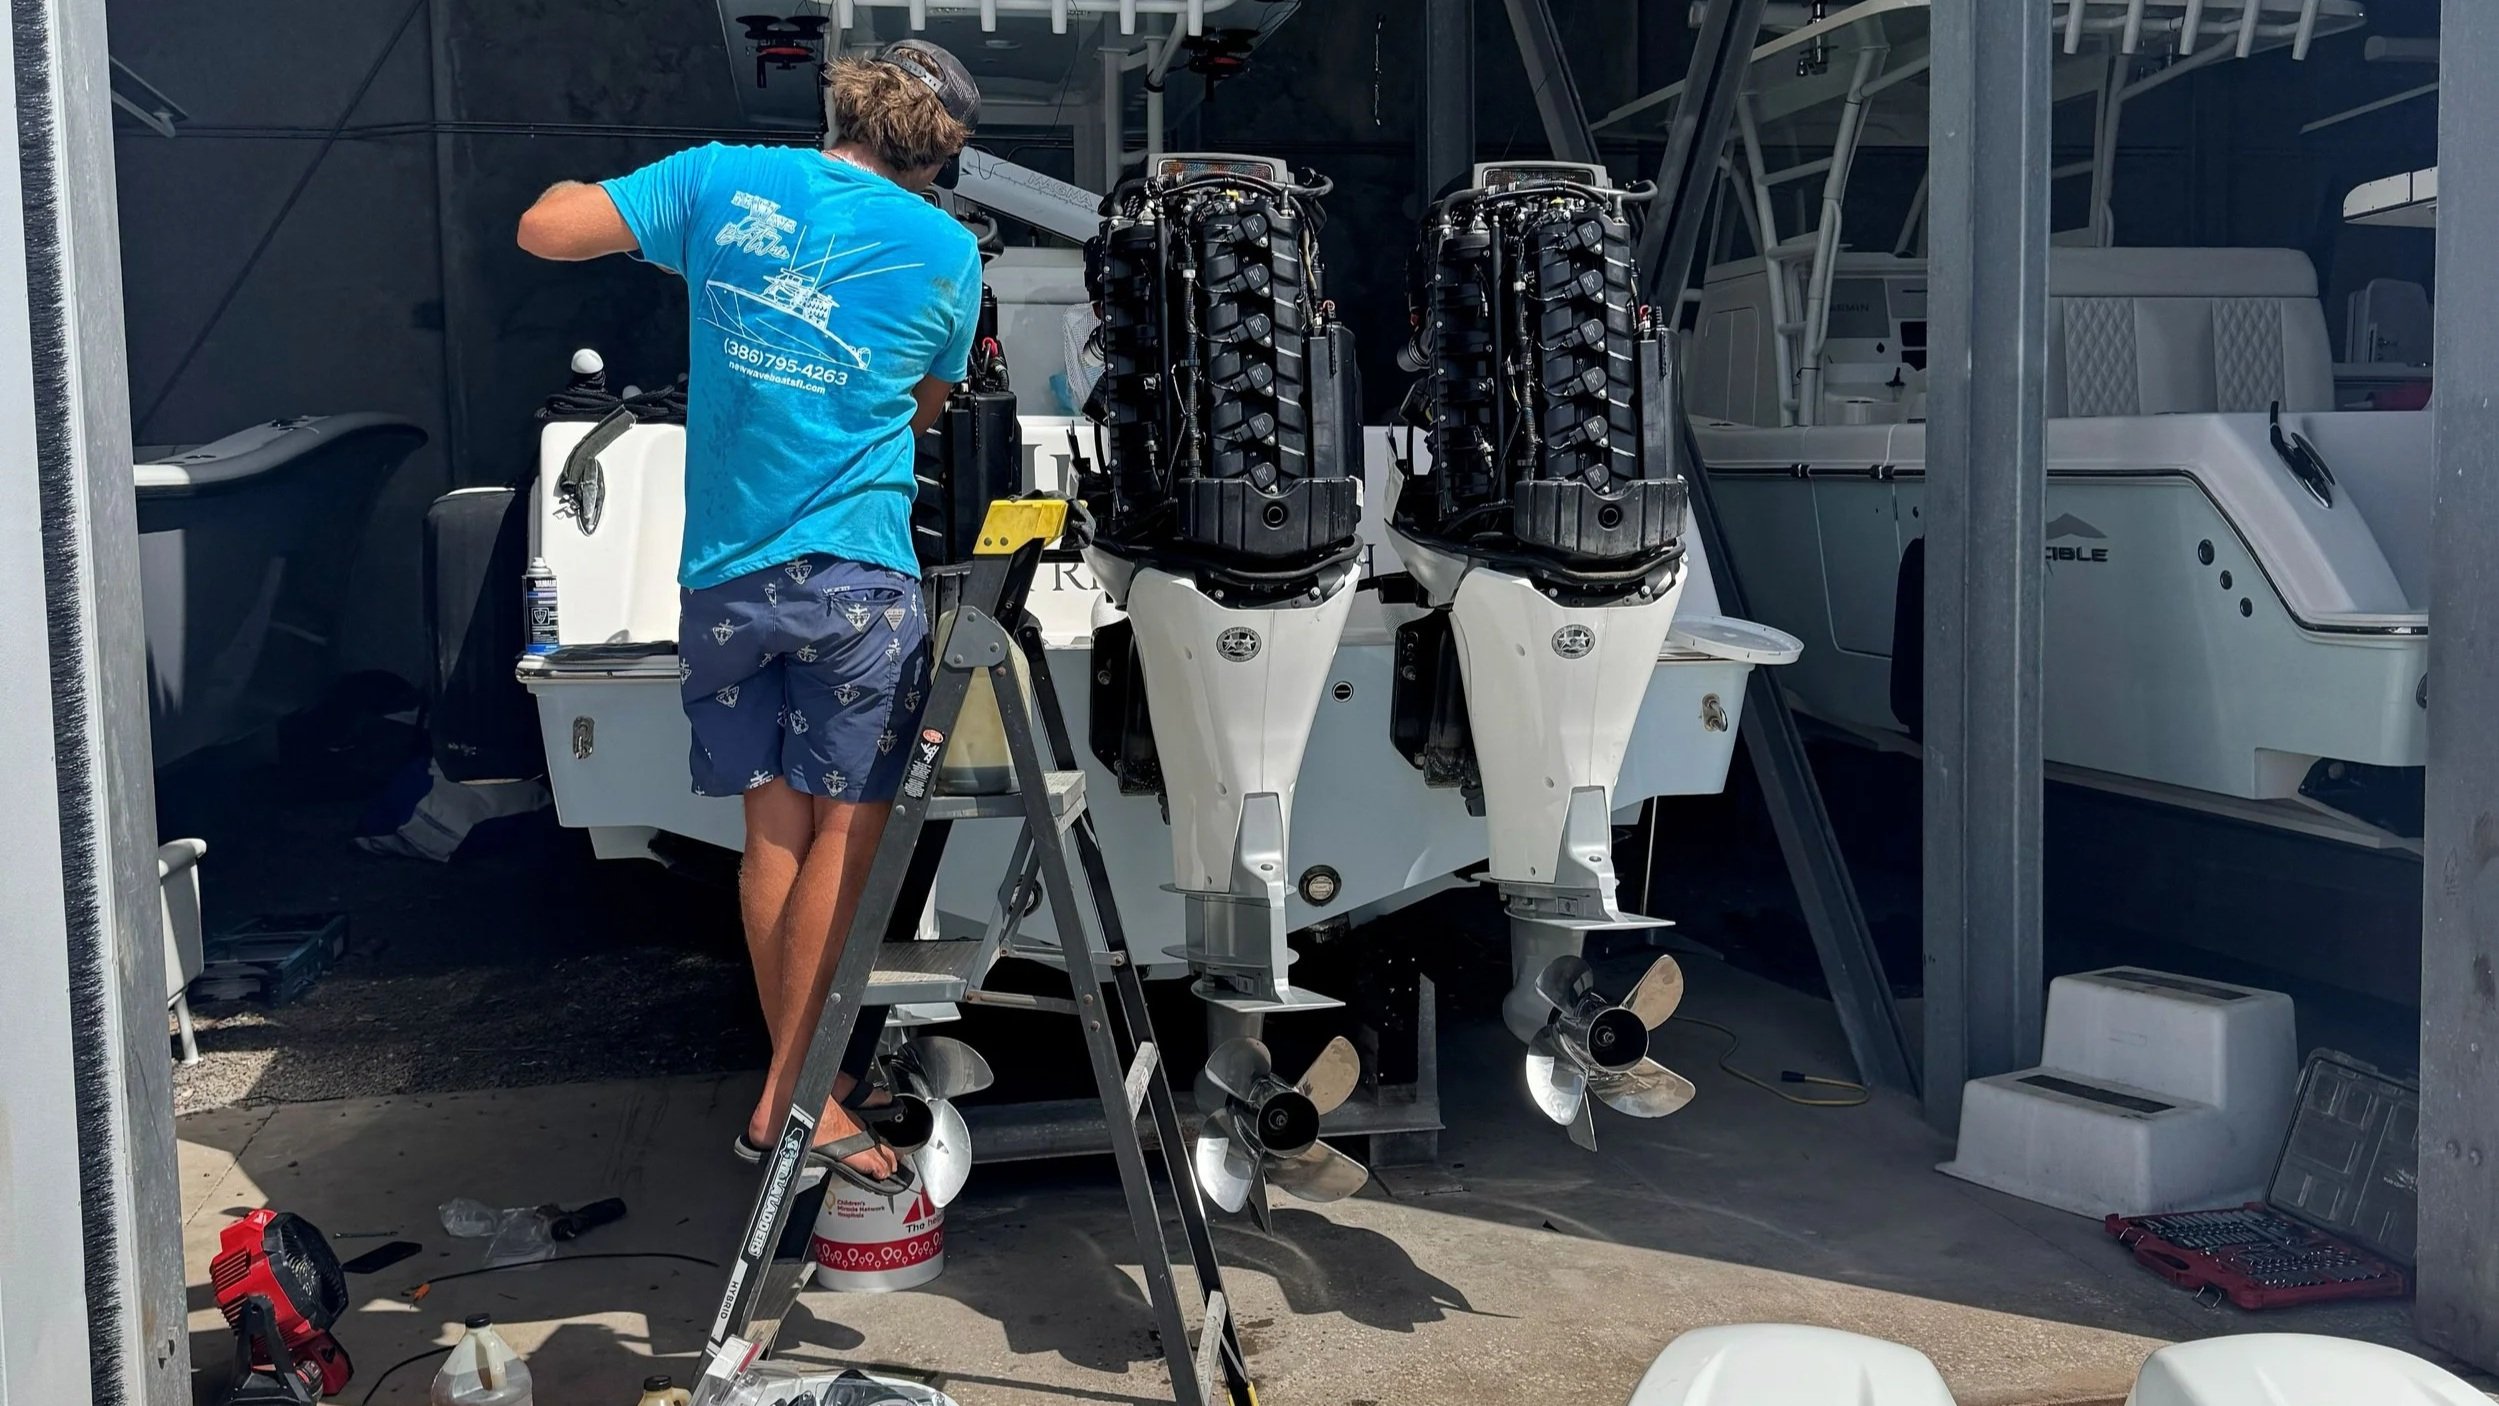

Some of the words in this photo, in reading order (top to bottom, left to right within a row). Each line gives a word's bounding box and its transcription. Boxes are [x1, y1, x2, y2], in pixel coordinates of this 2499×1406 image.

[723, 337, 849, 386] (386)795-4263
[728, 360, 826, 394] newwaveboatsfl.com
[748, 1195, 780, 1256] LADDERS
[720, 1280, 738, 1320] HYBRID
